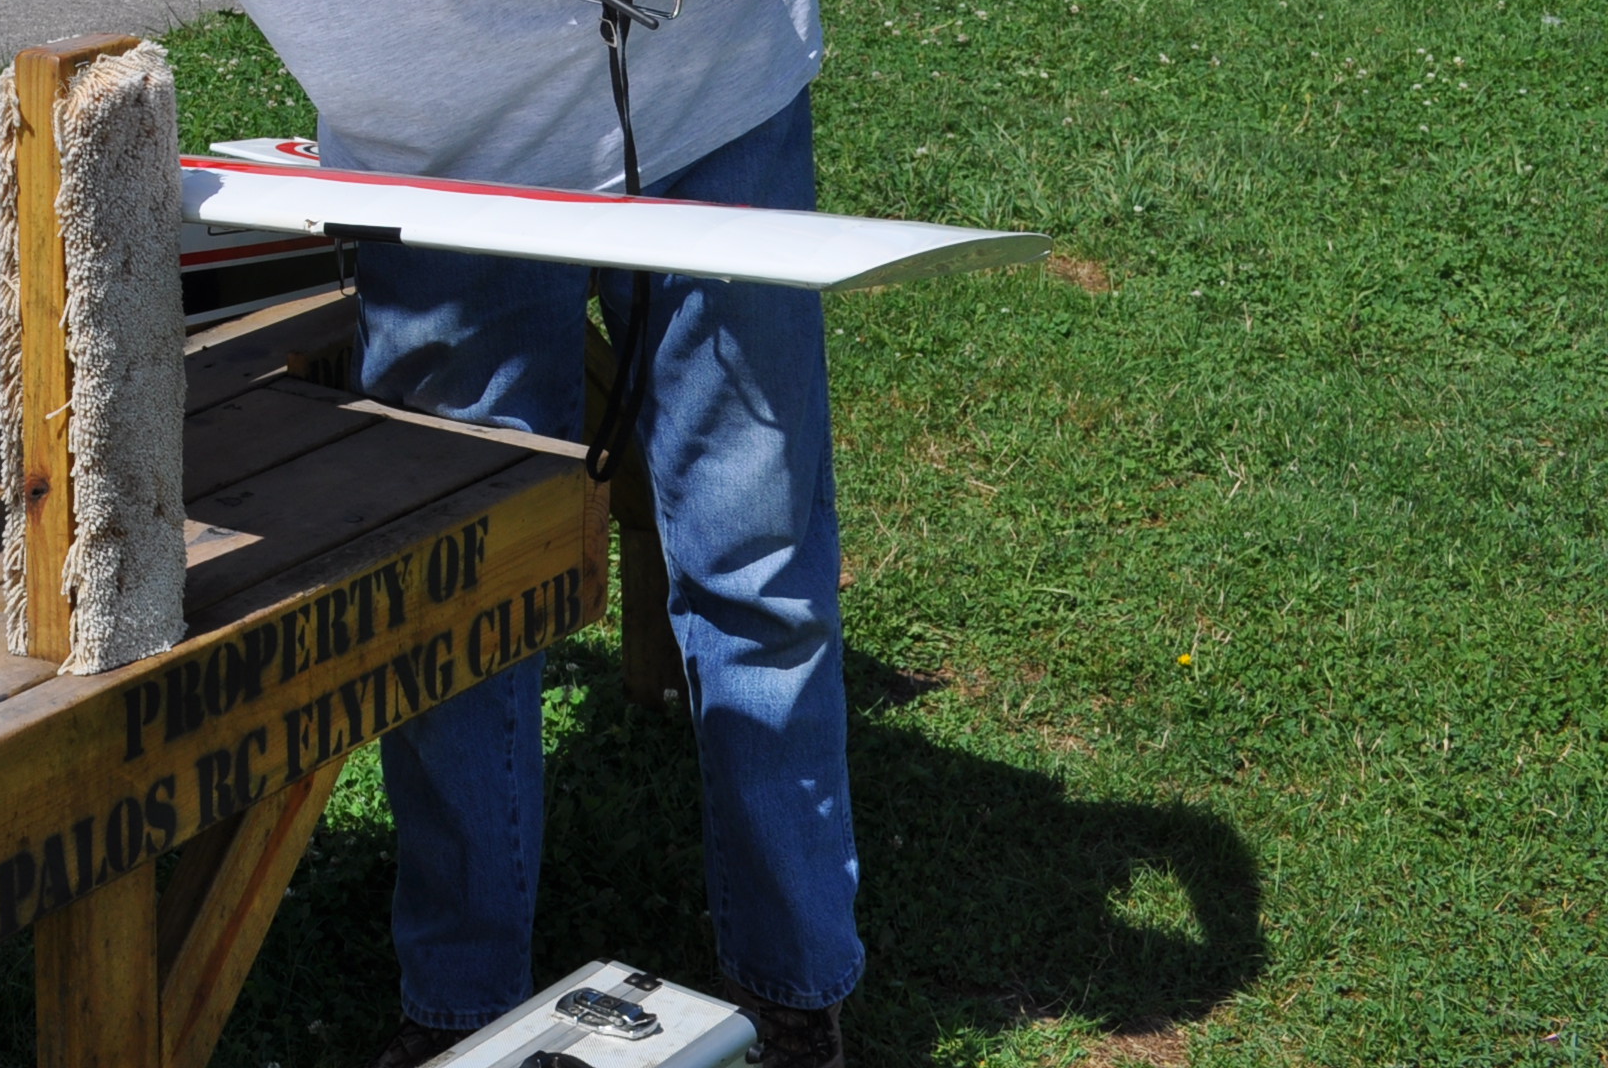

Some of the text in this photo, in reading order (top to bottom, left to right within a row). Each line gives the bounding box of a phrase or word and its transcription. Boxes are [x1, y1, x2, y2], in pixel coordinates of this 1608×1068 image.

[123, 517, 490, 762] PROPERTY OF
[196, 727, 268, 832] RC
[282, 632, 454, 783] FLYING
[466, 567, 583, 679] CLUB
